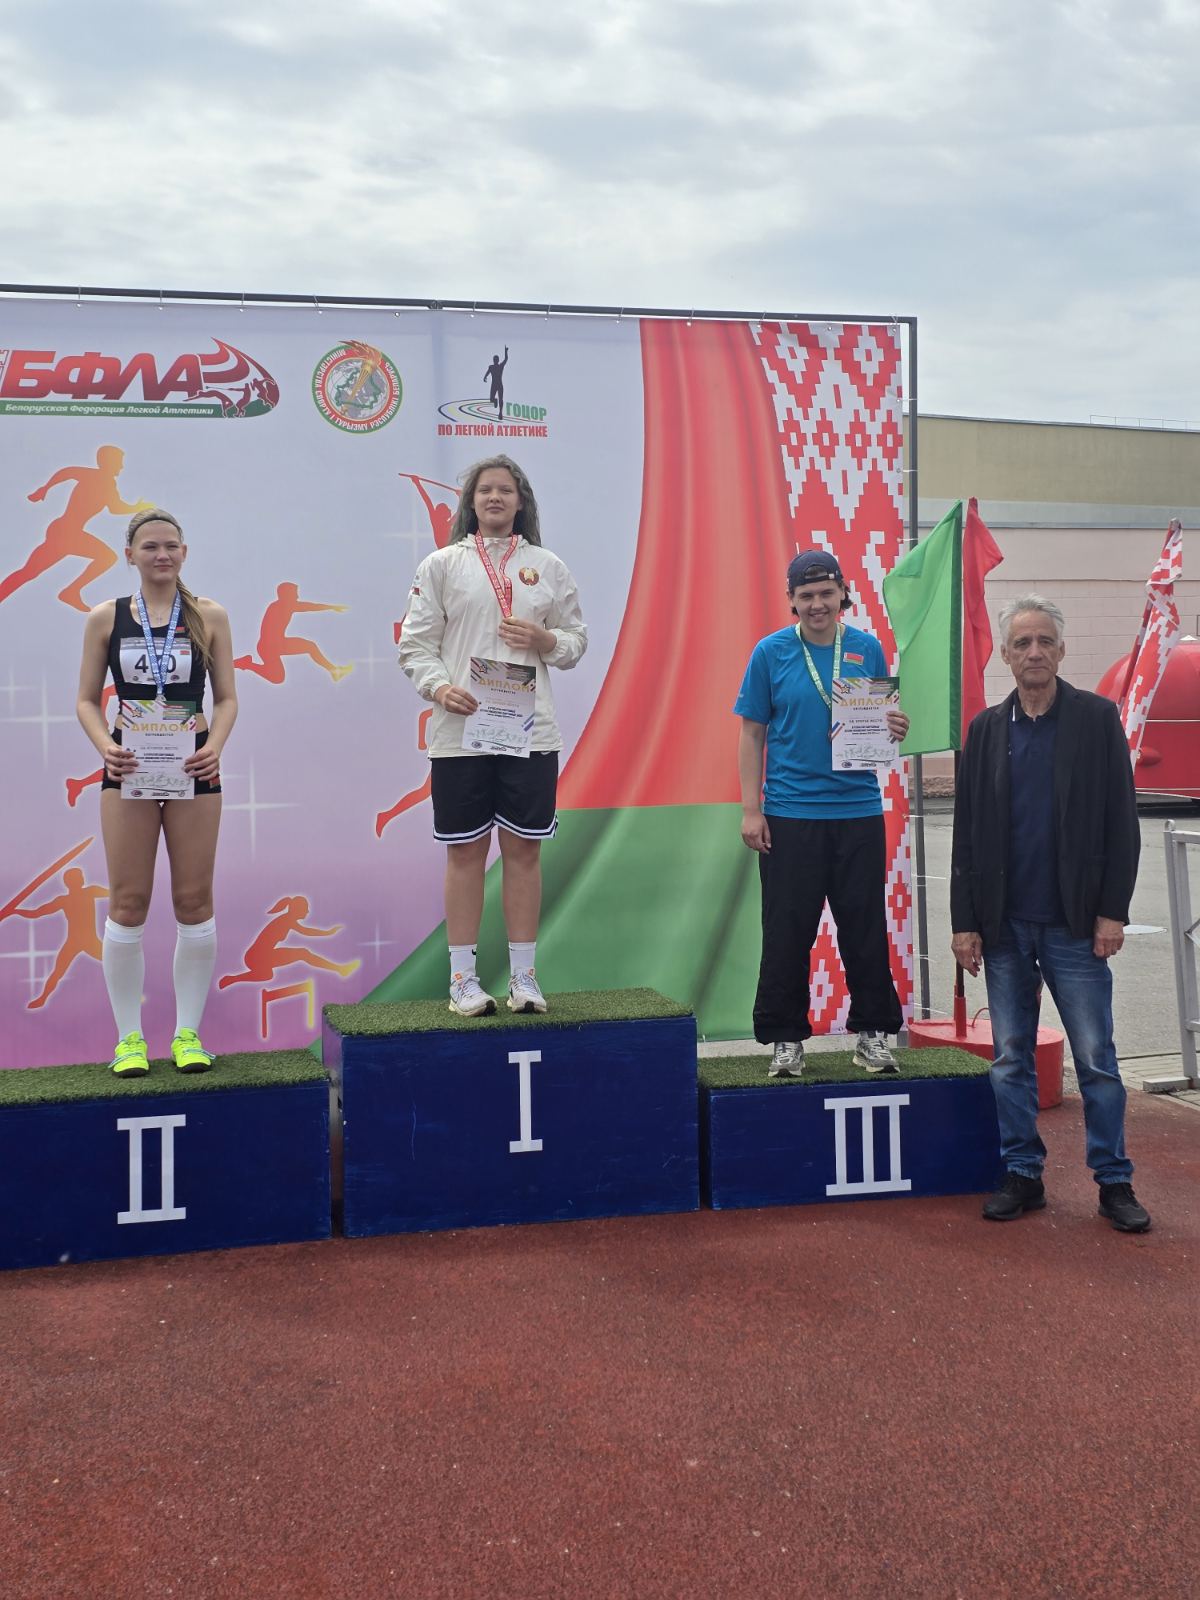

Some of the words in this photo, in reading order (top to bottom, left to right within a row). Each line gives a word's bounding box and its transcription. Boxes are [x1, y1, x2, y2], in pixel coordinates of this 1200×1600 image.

[0, 350, 203, 400] БФЛА
[5, 403, 68, 413] Белорусская
[70, 405, 125, 415] Федерация
[126, 406, 160, 414] Легкой
[162, 406, 214, 415] Атлетики
[438, 424, 452, 436] ПО
[455, 423, 494, 436] ЛЕГКОЙ
[497, 425, 548, 437] АТЛЕТИКЕ
[135, 654, 177, 673] 40
[480, 678, 529, 693] ДИПЛОМ
[840, 697, 893, 706] ДИПЛОМ
[131, 723, 189, 731] ДИПЛОМ
